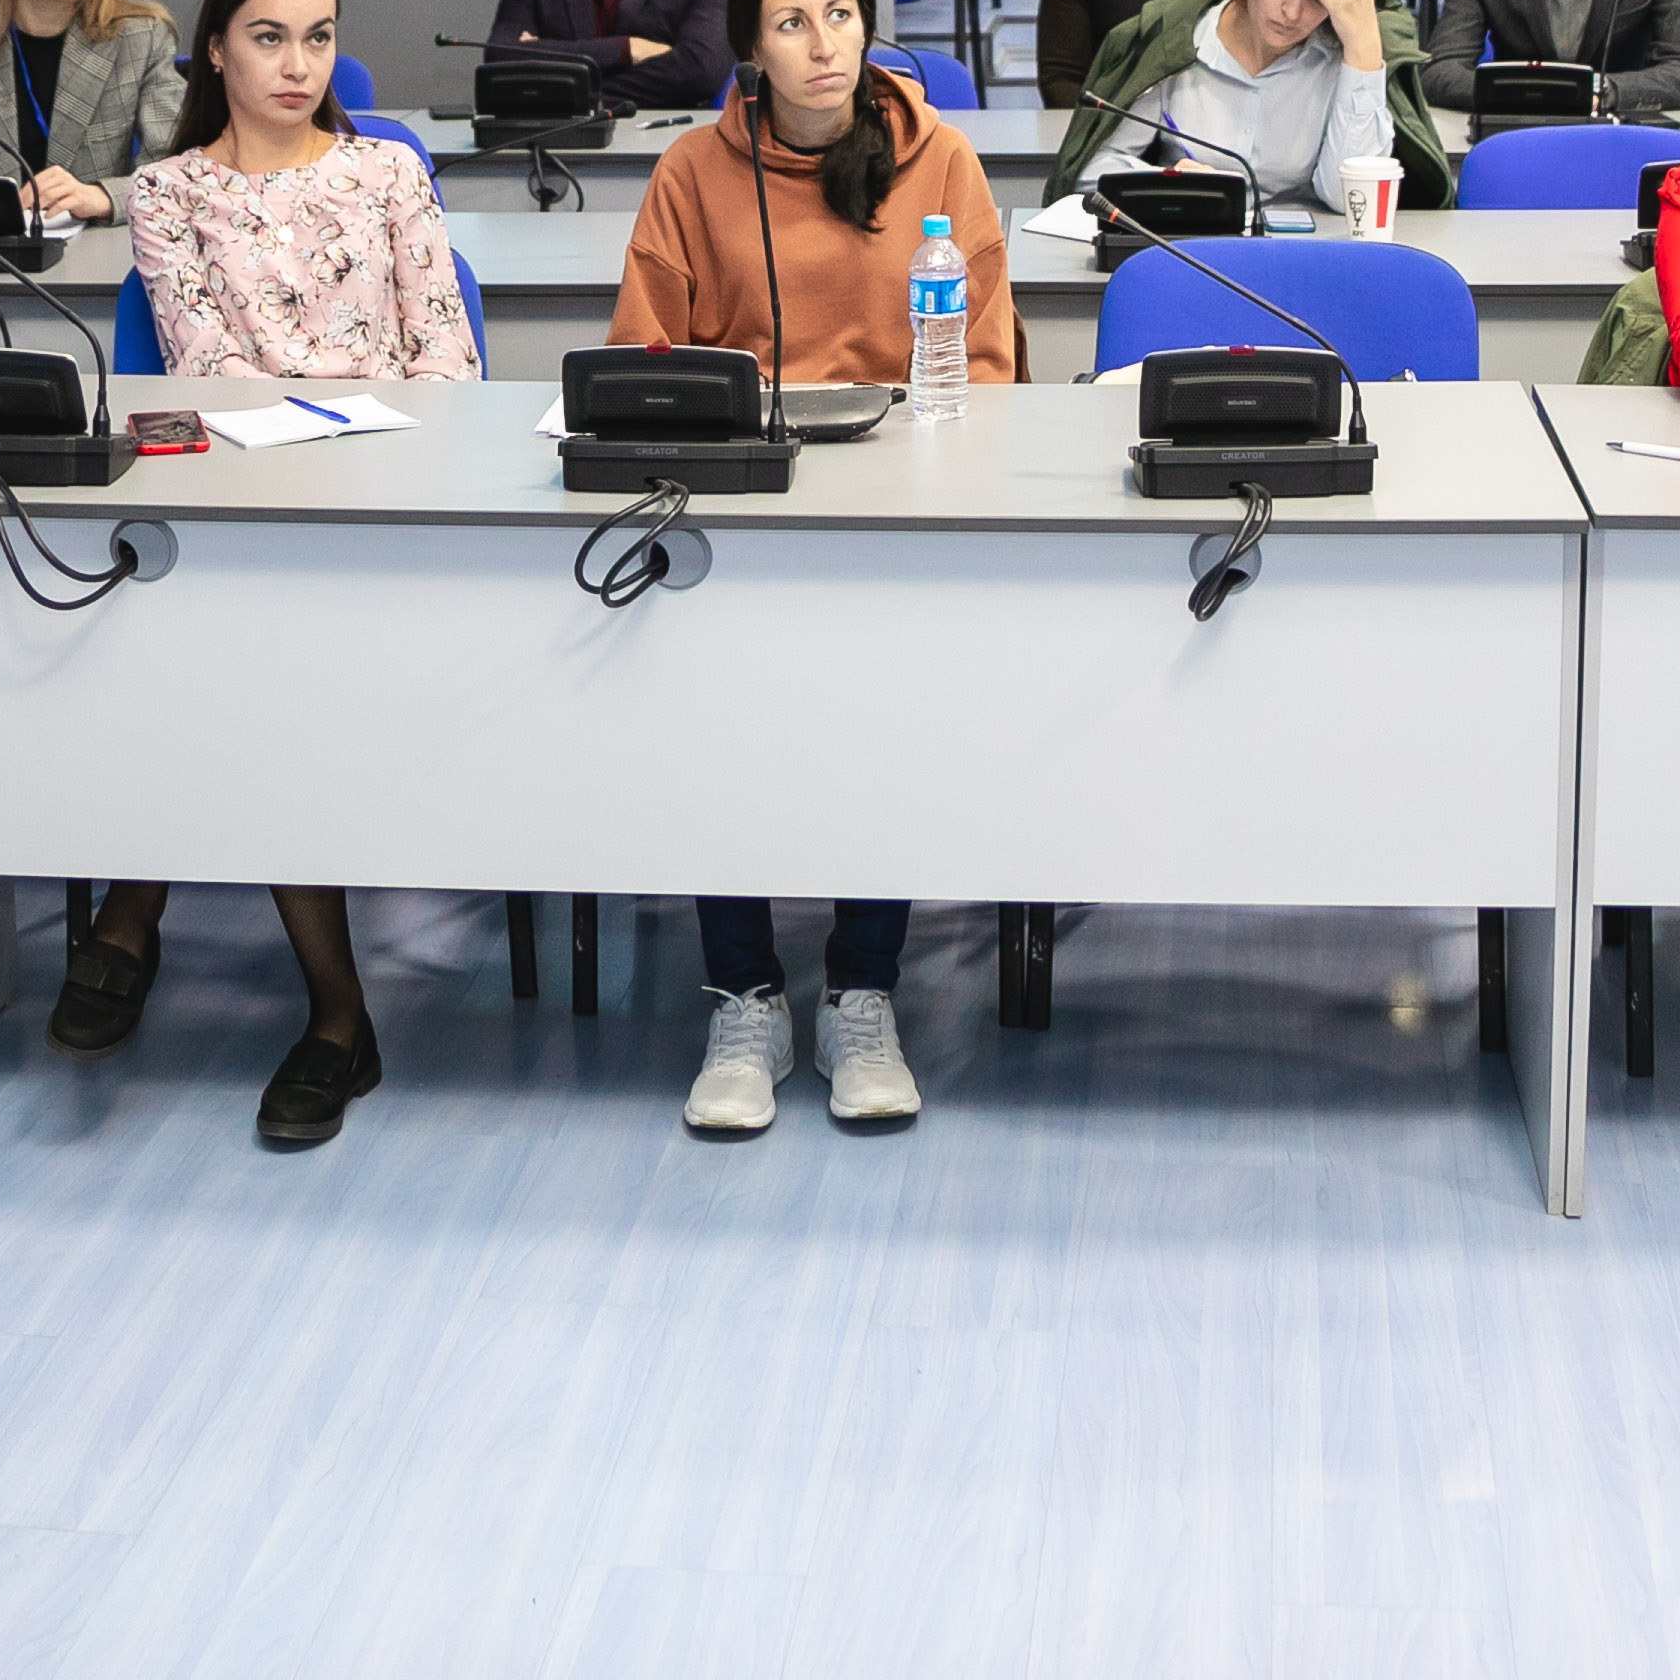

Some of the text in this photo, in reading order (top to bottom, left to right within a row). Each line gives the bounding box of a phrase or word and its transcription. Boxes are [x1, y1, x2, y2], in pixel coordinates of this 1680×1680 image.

[1352, 230, 1365, 238] KFC
[635, 447, 679, 456] CREATOR
[1221, 451, 1266, 460] CREATOR
